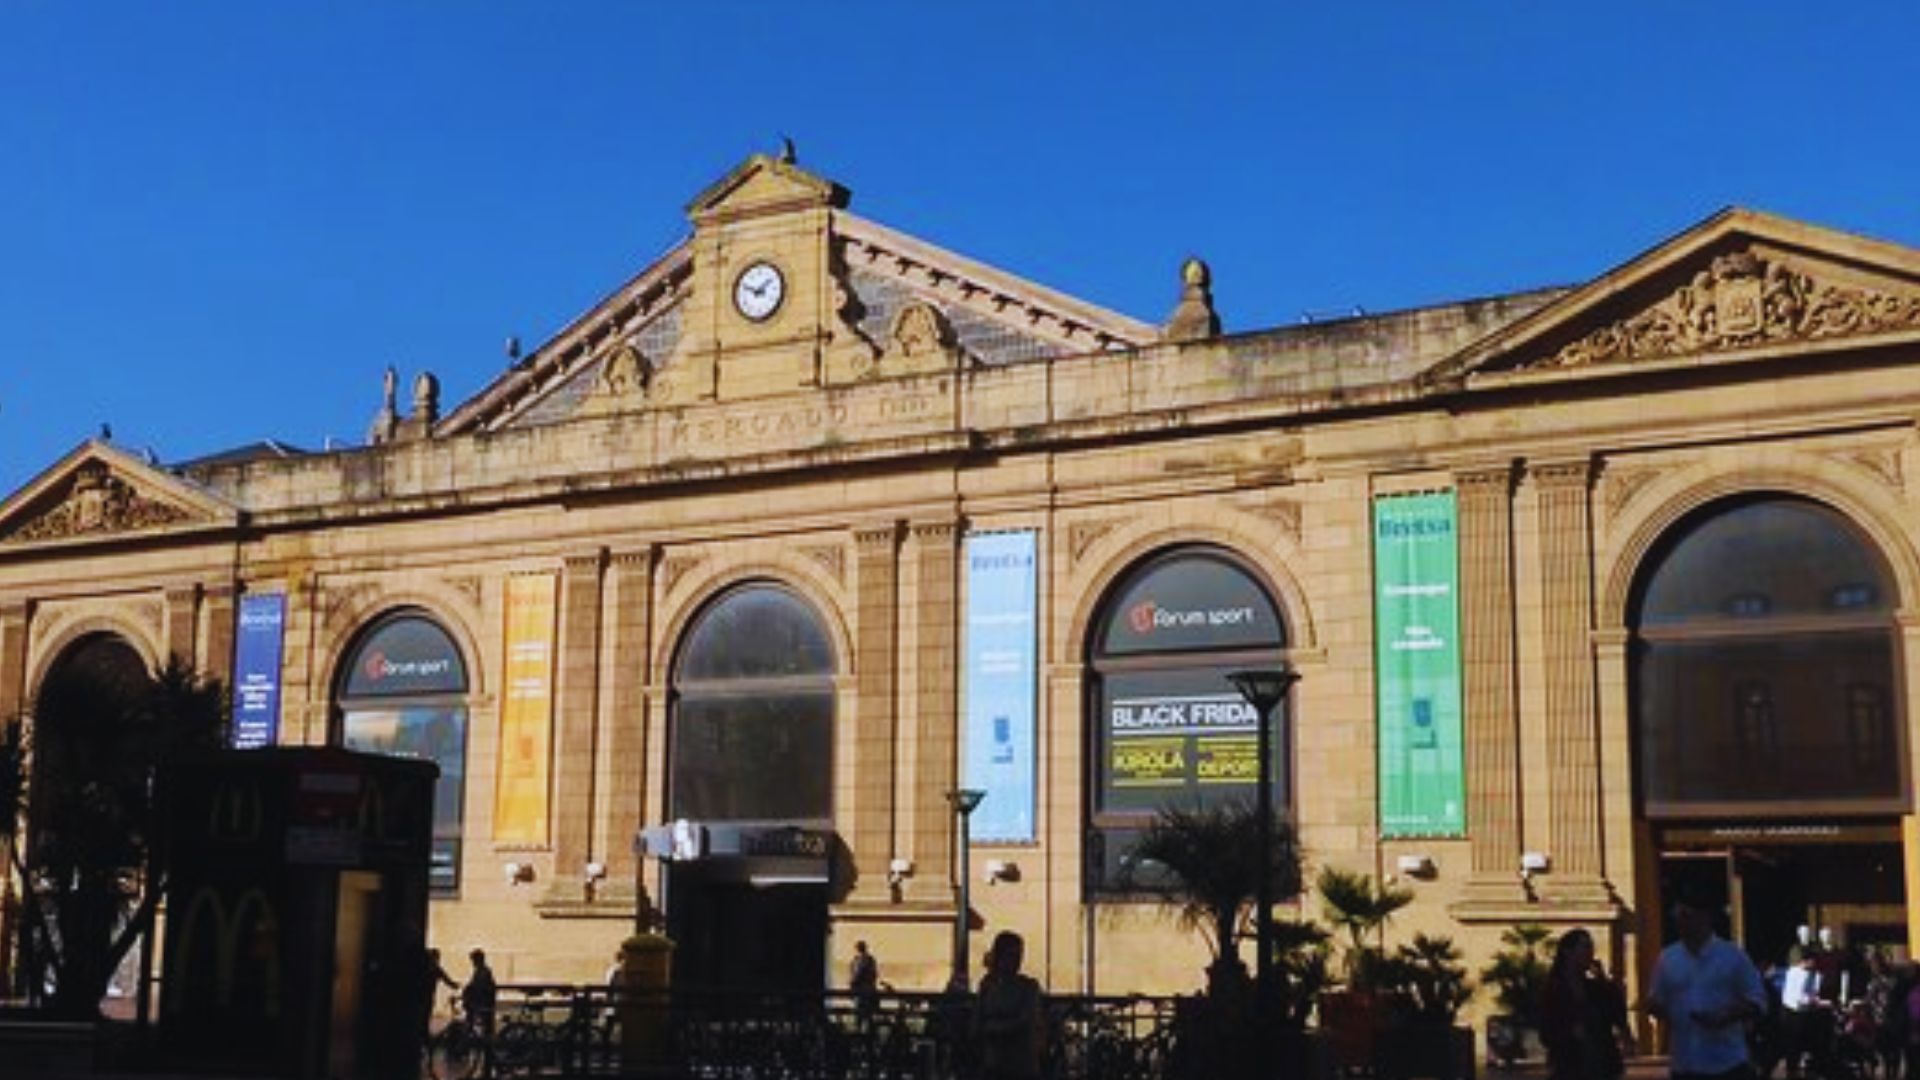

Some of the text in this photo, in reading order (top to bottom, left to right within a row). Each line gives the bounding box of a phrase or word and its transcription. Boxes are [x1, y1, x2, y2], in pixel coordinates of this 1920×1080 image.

[1112, 702, 1258, 727] BLACK FRIDA
[1197, 758, 1258, 777] DEPOR
